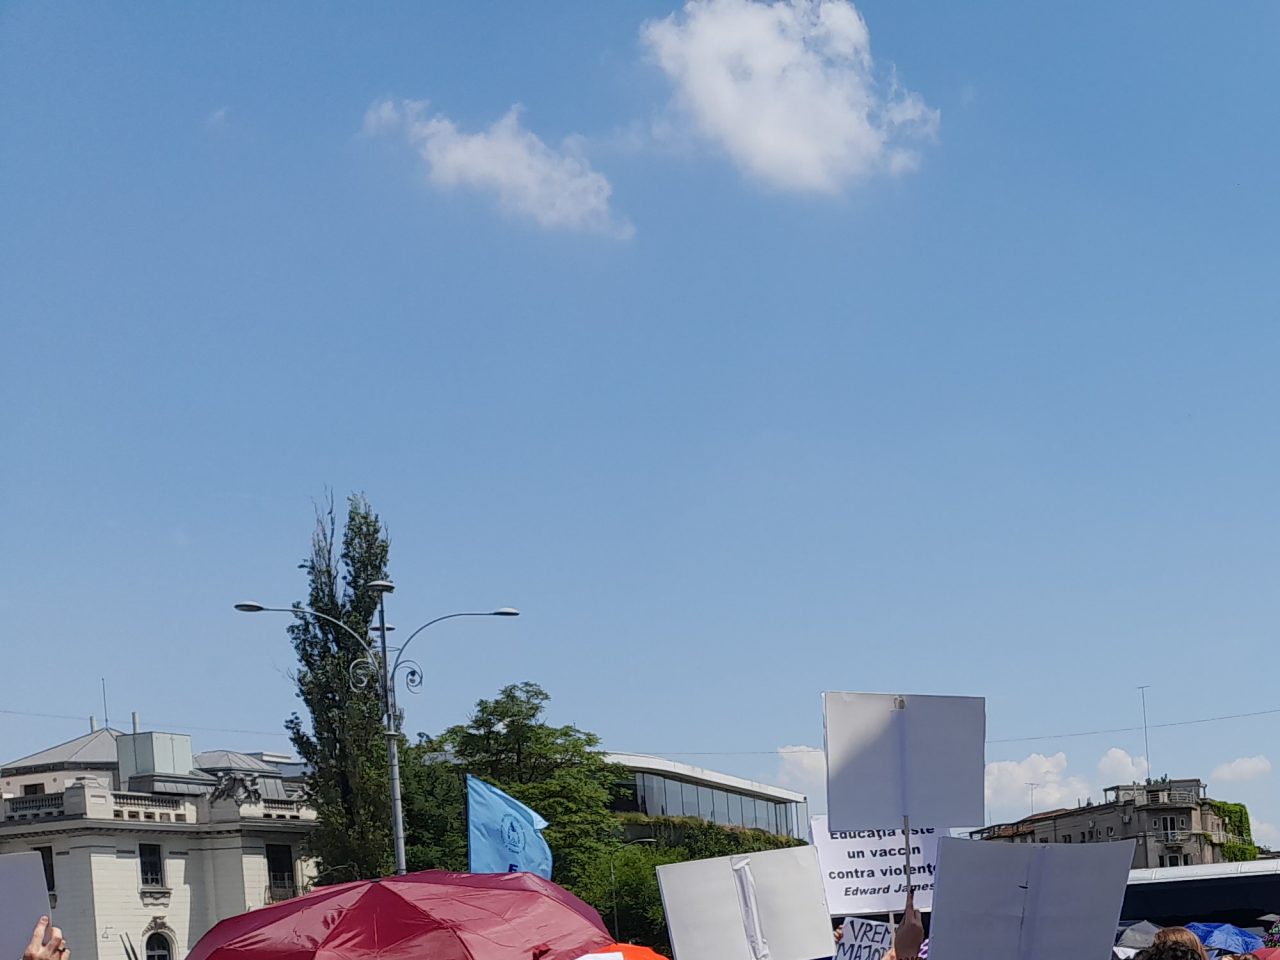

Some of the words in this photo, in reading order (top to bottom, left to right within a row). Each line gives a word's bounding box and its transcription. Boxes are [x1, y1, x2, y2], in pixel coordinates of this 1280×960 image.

[847, 850, 865, 859] un
[828, 868, 875, 880] contra
[844, 884, 890, 897] Edward
